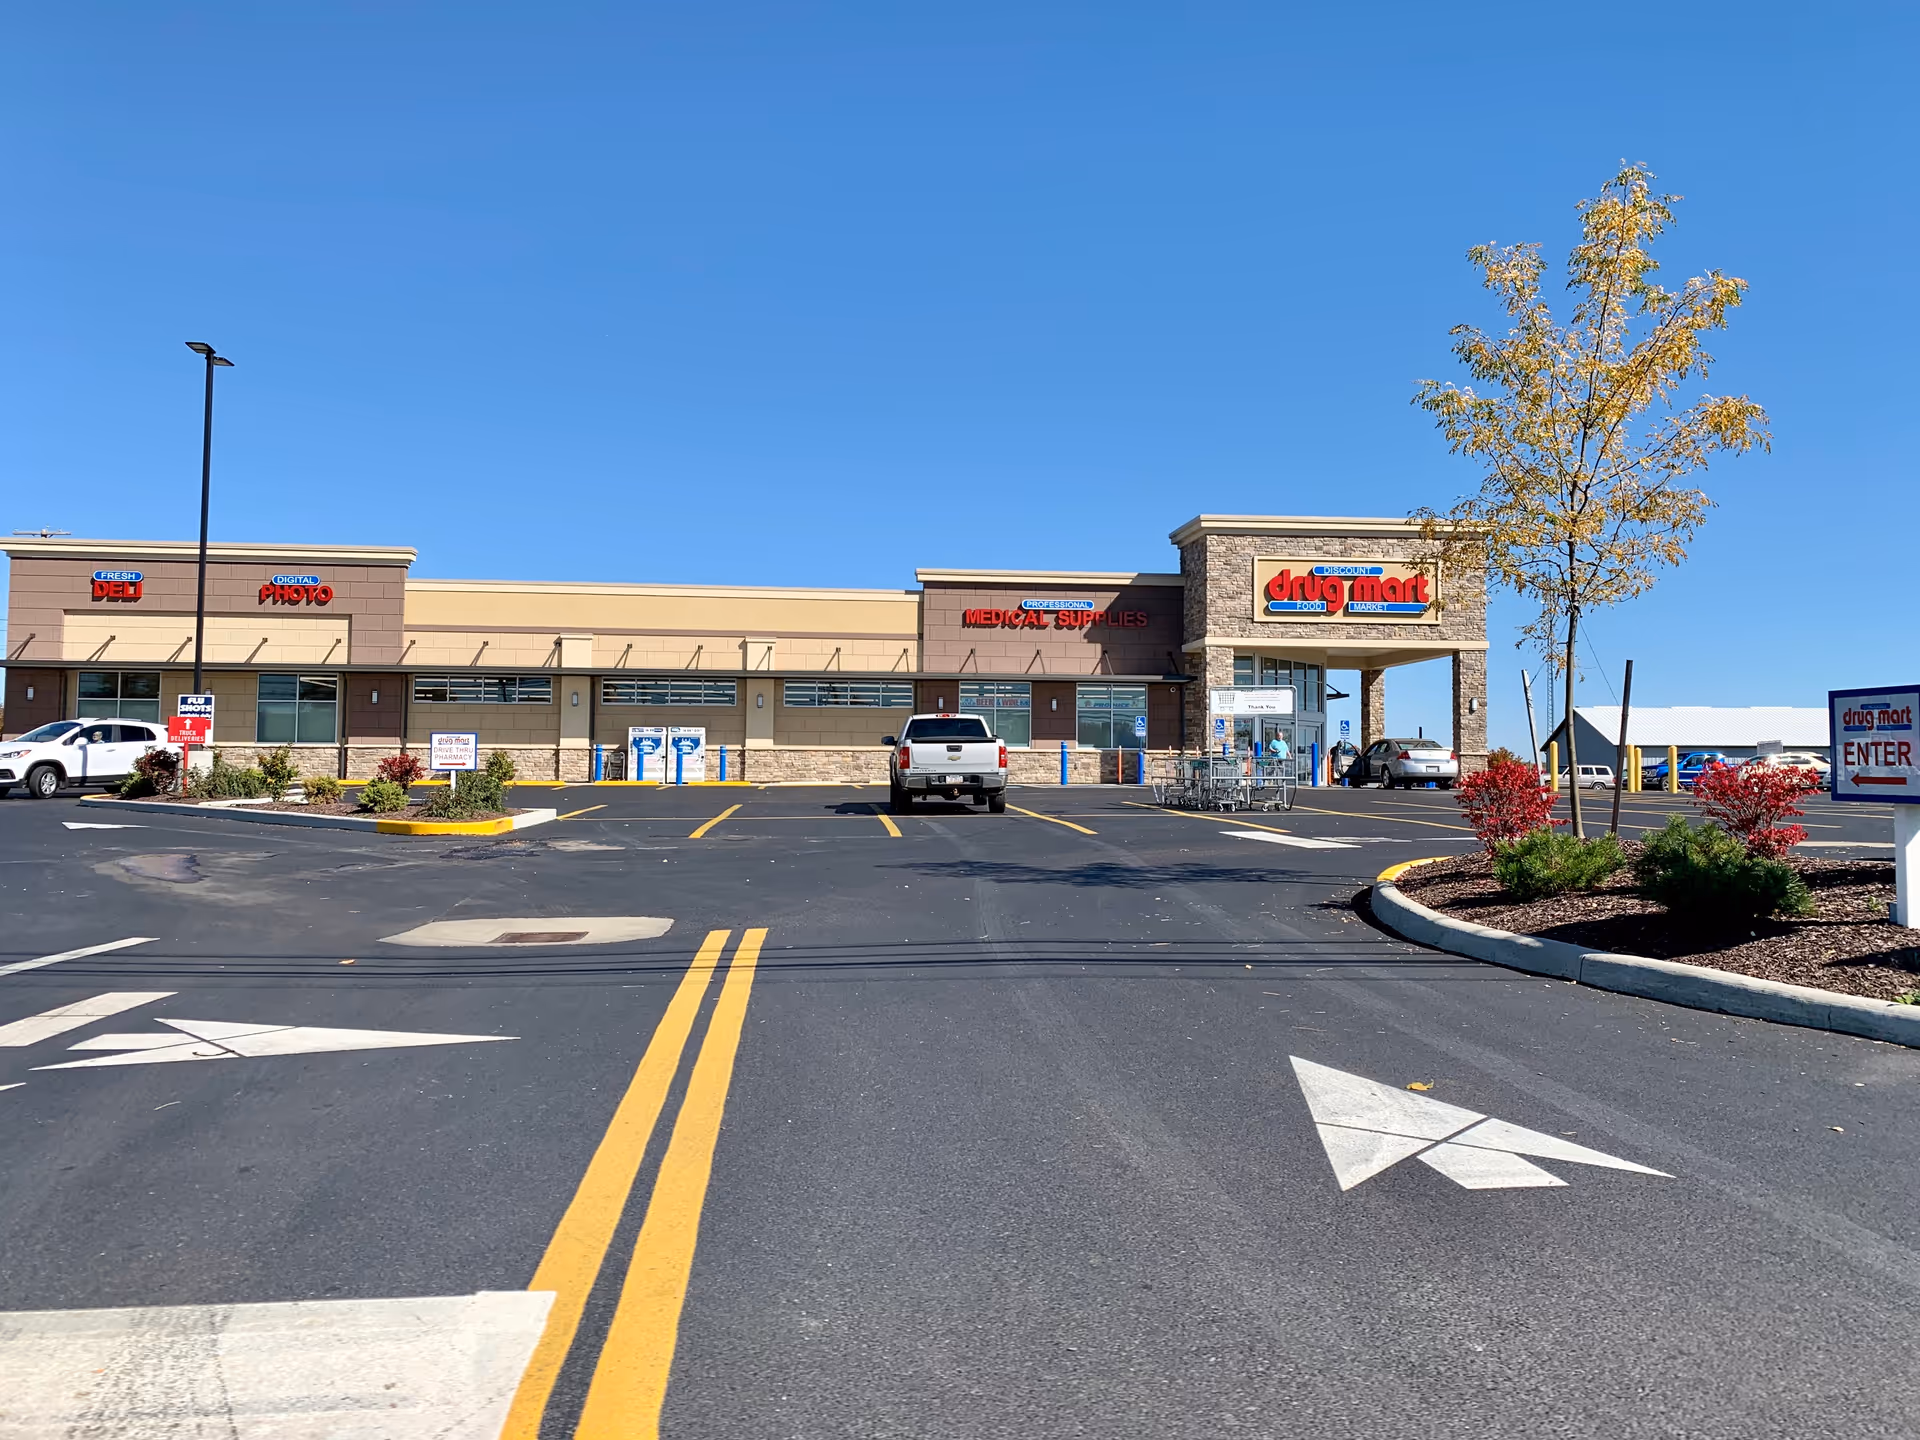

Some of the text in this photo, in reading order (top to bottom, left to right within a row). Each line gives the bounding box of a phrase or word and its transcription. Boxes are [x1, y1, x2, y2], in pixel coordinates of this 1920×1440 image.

[1323, 566, 1372, 575] DISCOUNT
[100, 572, 136, 581] FRESH
[277, 575, 315, 584] DIGITAL
[93, 581, 143, 598] DELI
[261, 584, 333, 602] PHOTO
[1268, 569, 1430, 612] drug mart
[1026, 600, 1090, 609] PROFESSIONAL
[1296, 602, 1322, 610] FOOD
[1353, 603, 1389, 612] MARKET
[966, 609, 1148, 627] MEDICAL SUPPLIES
[1843, 705, 1912, 731] drug mart
[438, 737, 453, 745] drug
[1843, 741, 1912, 766] ENTER
